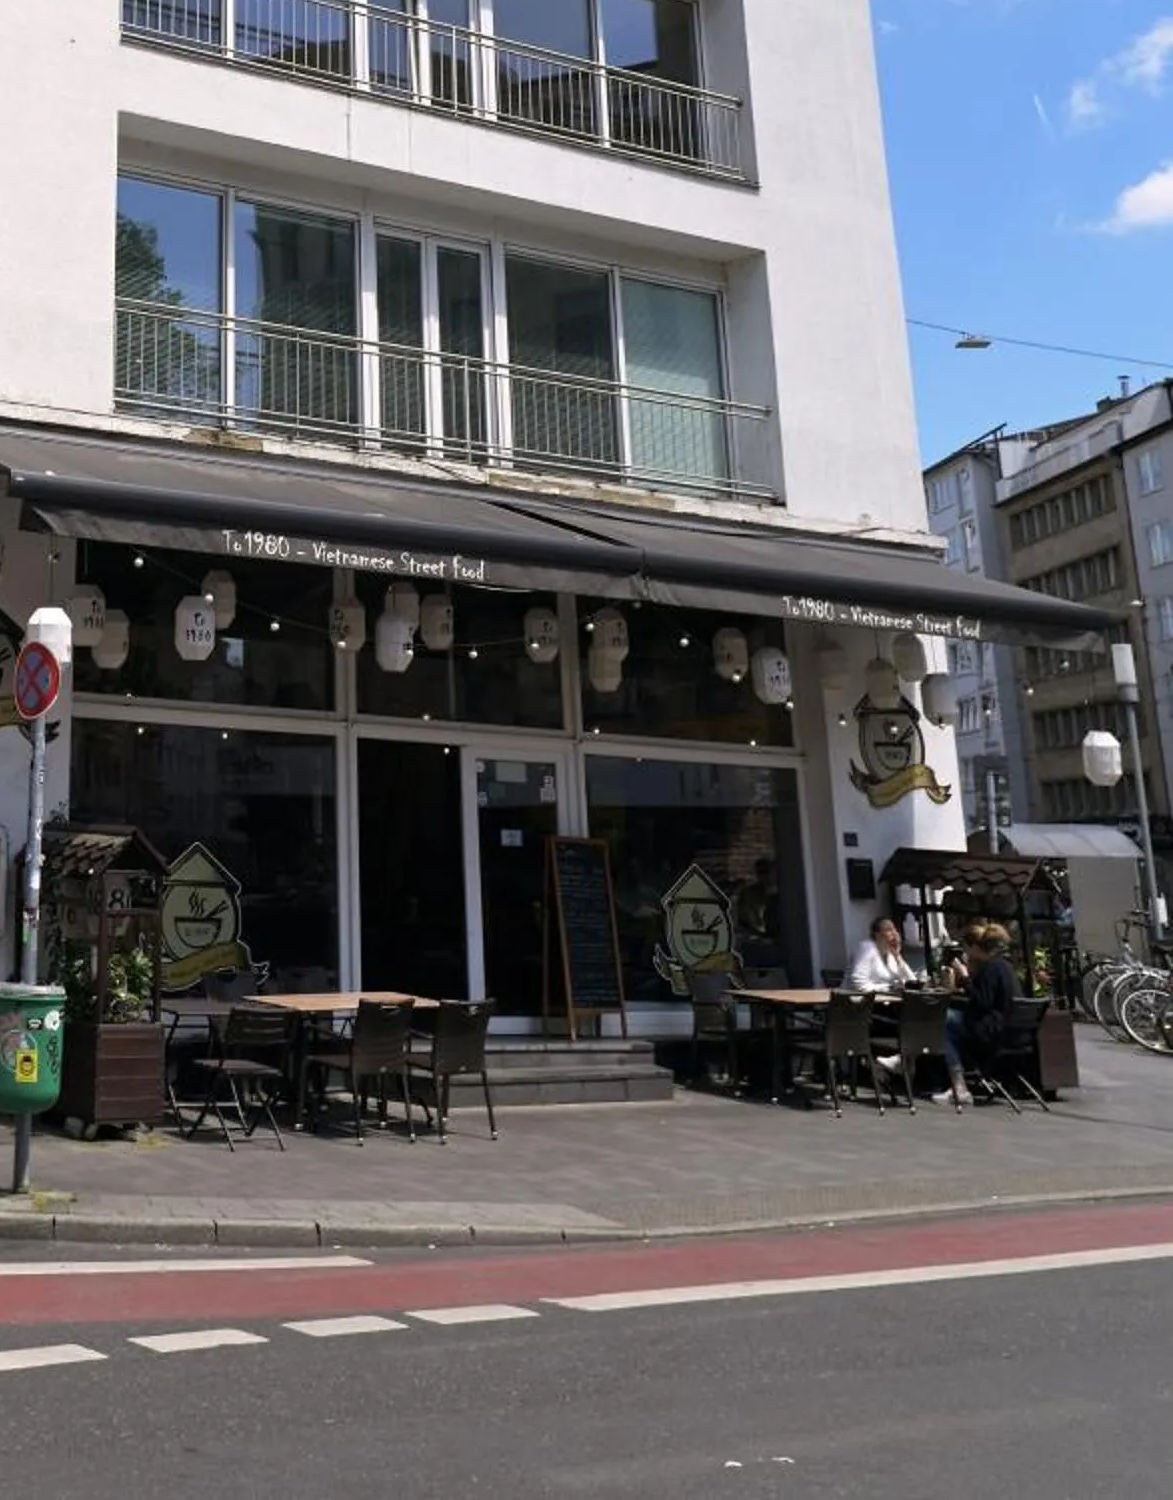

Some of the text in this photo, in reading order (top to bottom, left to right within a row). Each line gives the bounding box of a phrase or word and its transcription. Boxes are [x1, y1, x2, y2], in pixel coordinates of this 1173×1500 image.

[312, 541, 395, 571] Vietnamese
[400, 551, 446, 578] Street
[453, 554, 484, 582] Food
[850, 605, 913, 630] Vietnamese
[916, 613, 952, 636] Street
